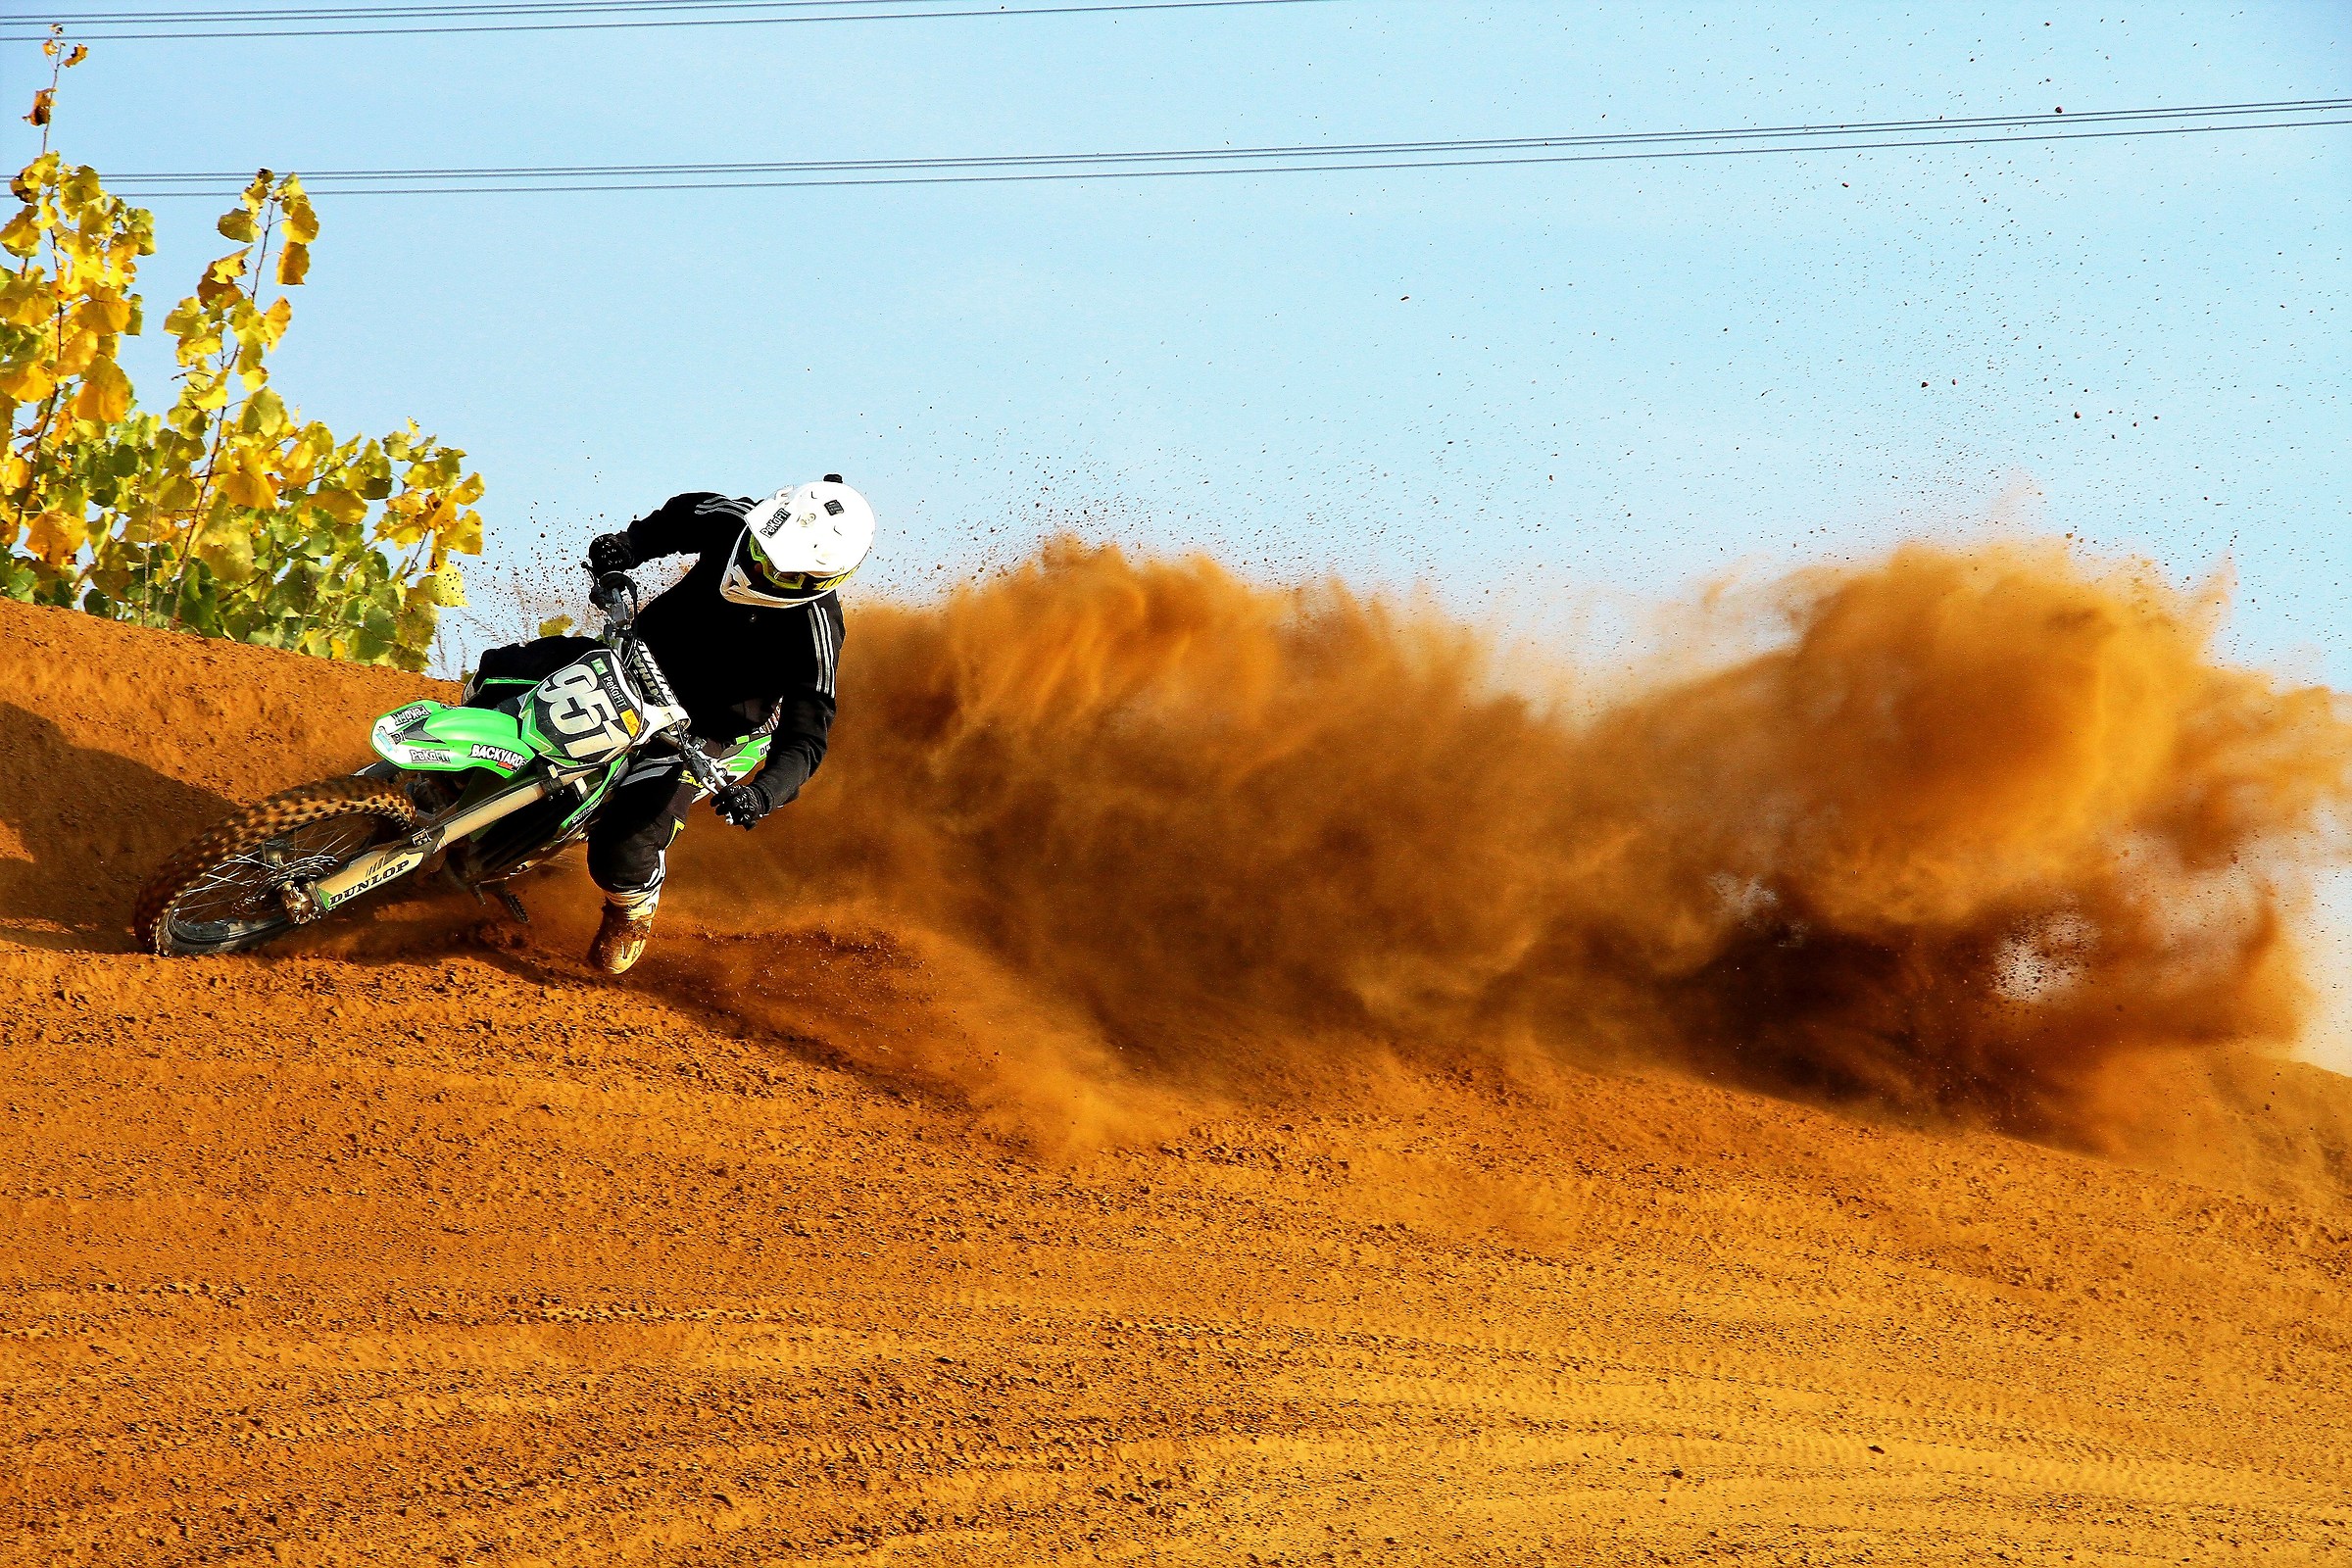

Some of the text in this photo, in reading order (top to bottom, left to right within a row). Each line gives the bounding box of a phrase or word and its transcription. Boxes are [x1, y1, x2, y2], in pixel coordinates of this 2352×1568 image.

[760, 508, 791, 538] PeKaFIT
[603, 675, 627, 709] PeKaFIT
[637, 640, 678, 706] ENTHAL
[329, 859, 409, 906] DUNLOP
